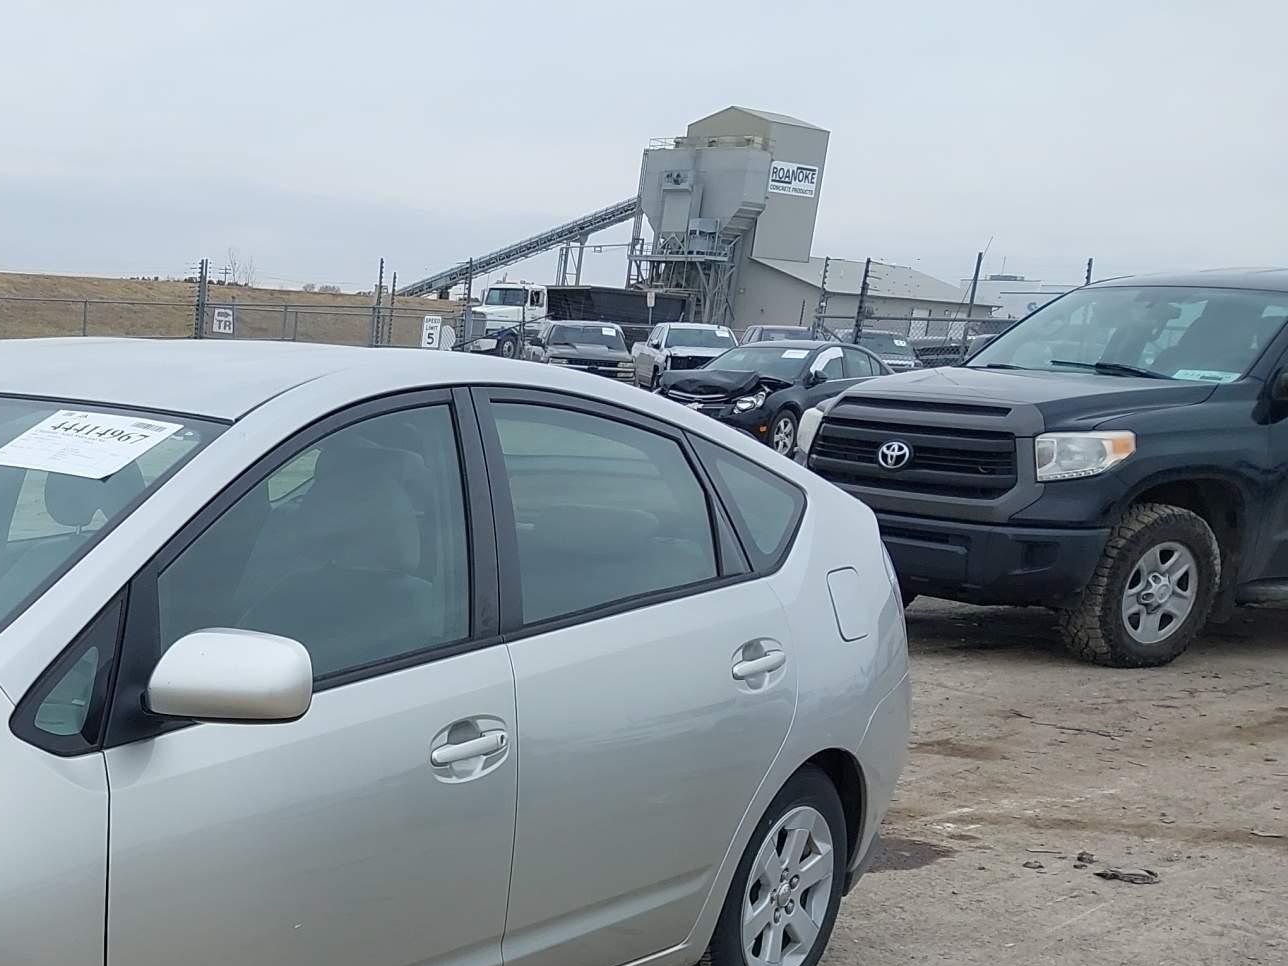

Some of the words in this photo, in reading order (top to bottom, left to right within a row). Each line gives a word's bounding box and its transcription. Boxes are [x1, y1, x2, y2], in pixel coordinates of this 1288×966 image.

[772, 167, 816, 184] ROANOKE
[216, 319, 232, 331] TR
[426, 332, 435, 345] 5
[51, 421, 150, 445] 44414967
